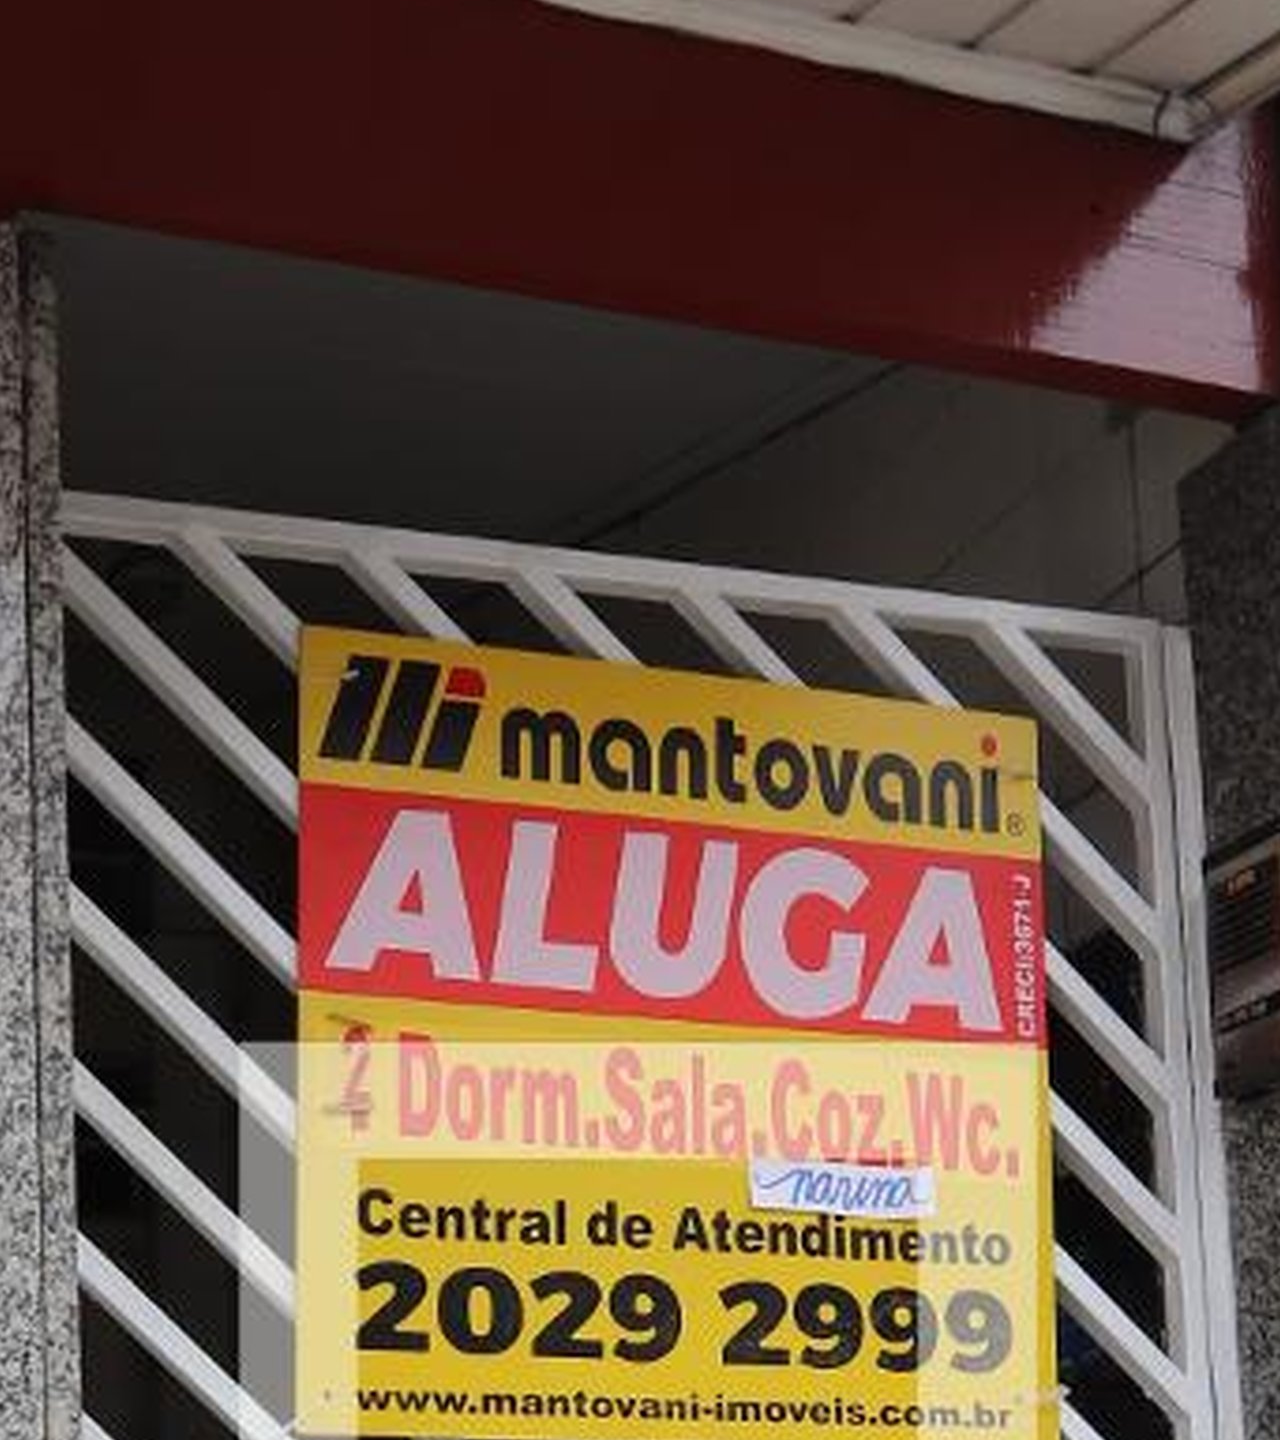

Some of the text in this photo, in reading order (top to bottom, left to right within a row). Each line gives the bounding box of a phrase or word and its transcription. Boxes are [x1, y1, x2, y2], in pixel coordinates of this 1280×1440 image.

[500, 706, 1001, 834] mantovani
[325, 808, 1004, 1032] ALUGA
[357, 1188, 1012, 1266] Central de Atendimento
[355, 1259, 1015, 1374] 2029 2999
[356, 1388, 1013, 1430] www.mantovani-imoveis.com.br
